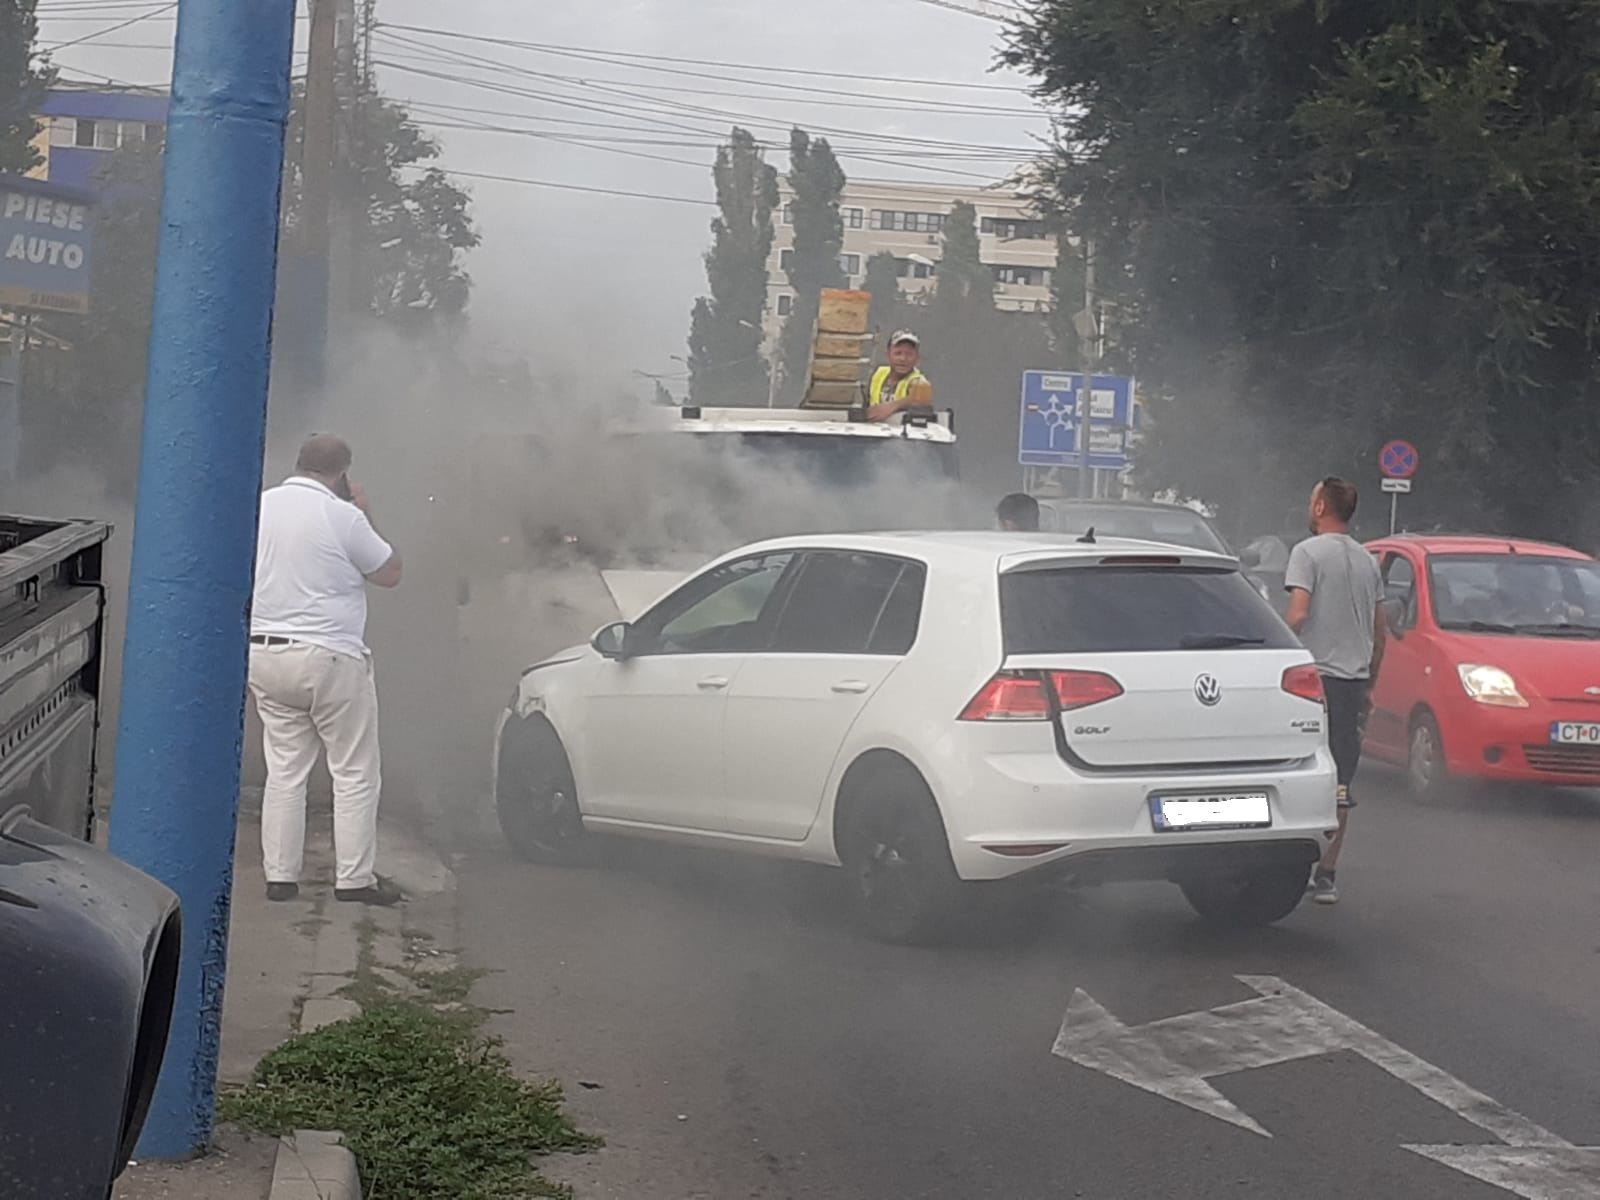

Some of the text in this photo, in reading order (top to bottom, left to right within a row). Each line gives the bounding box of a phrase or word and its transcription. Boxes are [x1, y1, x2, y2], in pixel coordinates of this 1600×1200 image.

[4, 192, 86, 231] PIESE
[5, 233, 84, 269] AUTO
[1074, 726, 1112, 735] GOLF
[1562, 725, 1583, 741] CT
